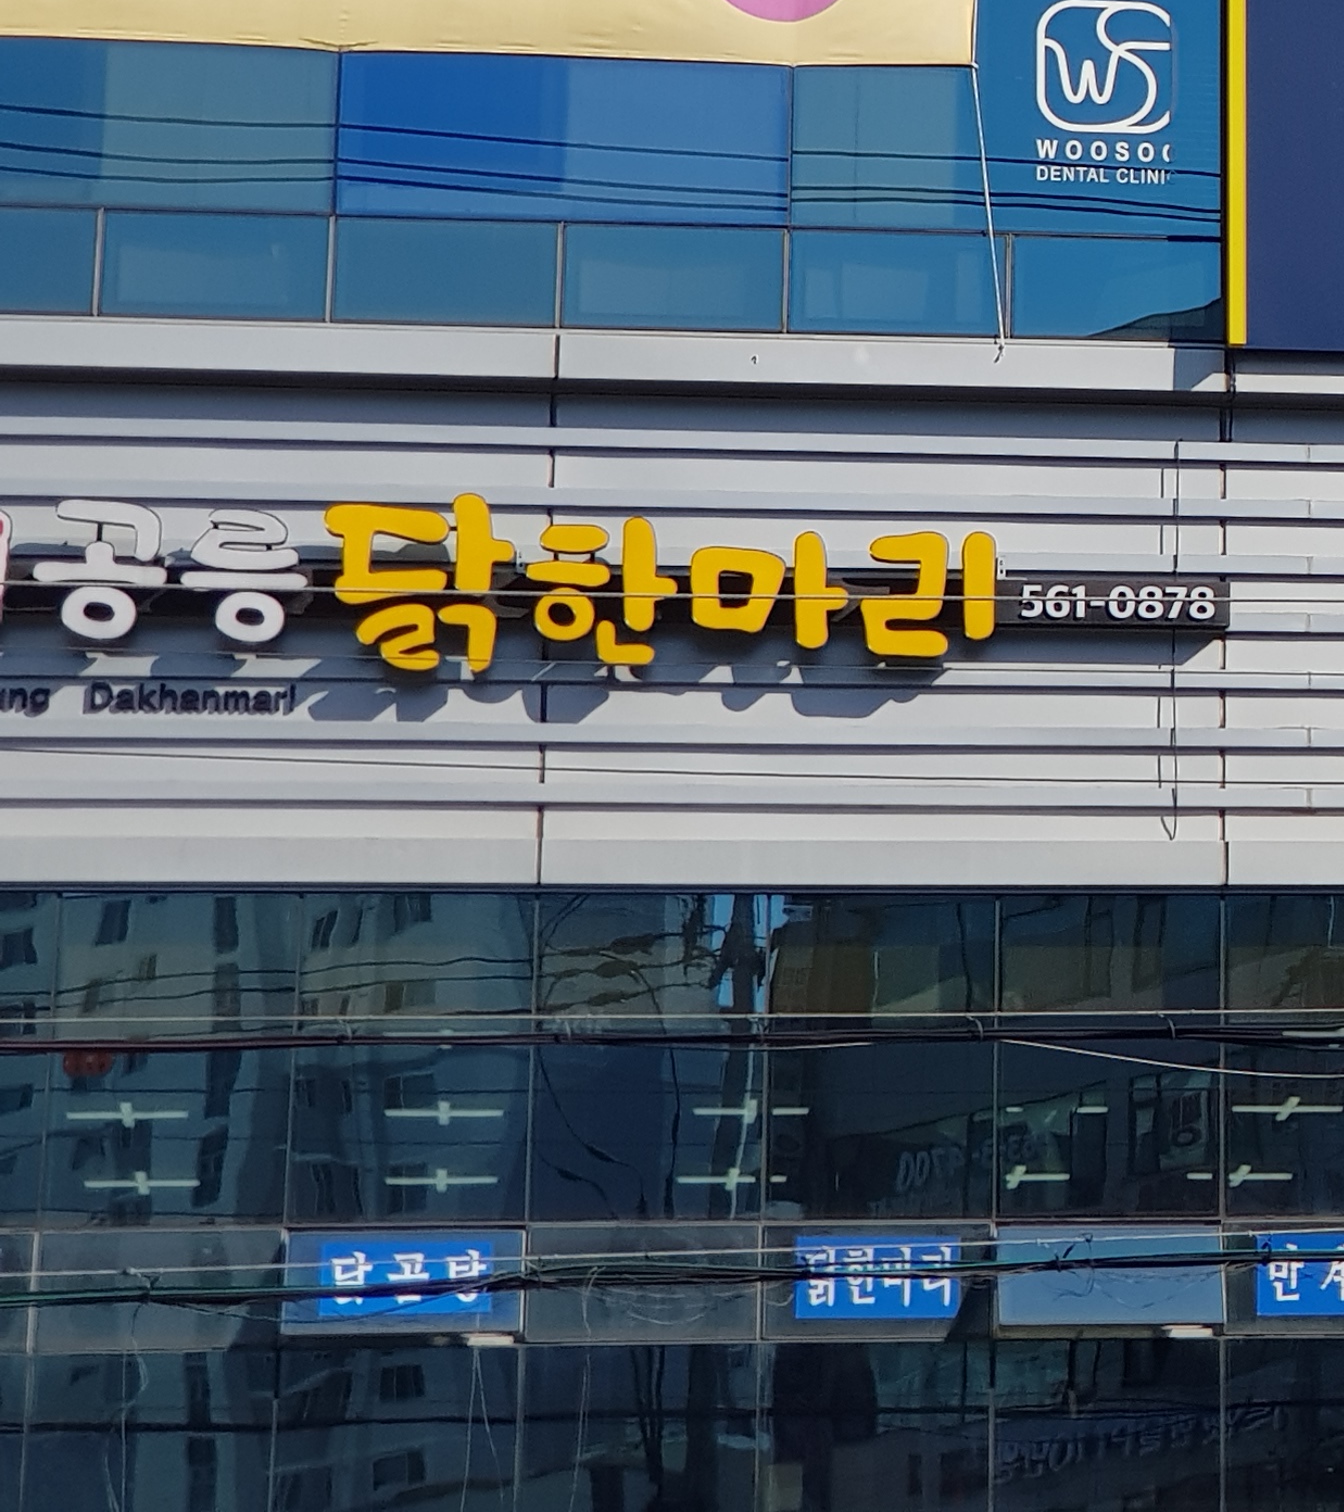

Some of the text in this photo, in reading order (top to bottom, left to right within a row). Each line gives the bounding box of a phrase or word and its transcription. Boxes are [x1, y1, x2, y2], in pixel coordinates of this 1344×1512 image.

[1036, 166, 1173, 186] DENTAL CLINI
[33, 492, 998, 673] 공릉 닭한마리
[1019, 580, 1217, 623] 561-0878
